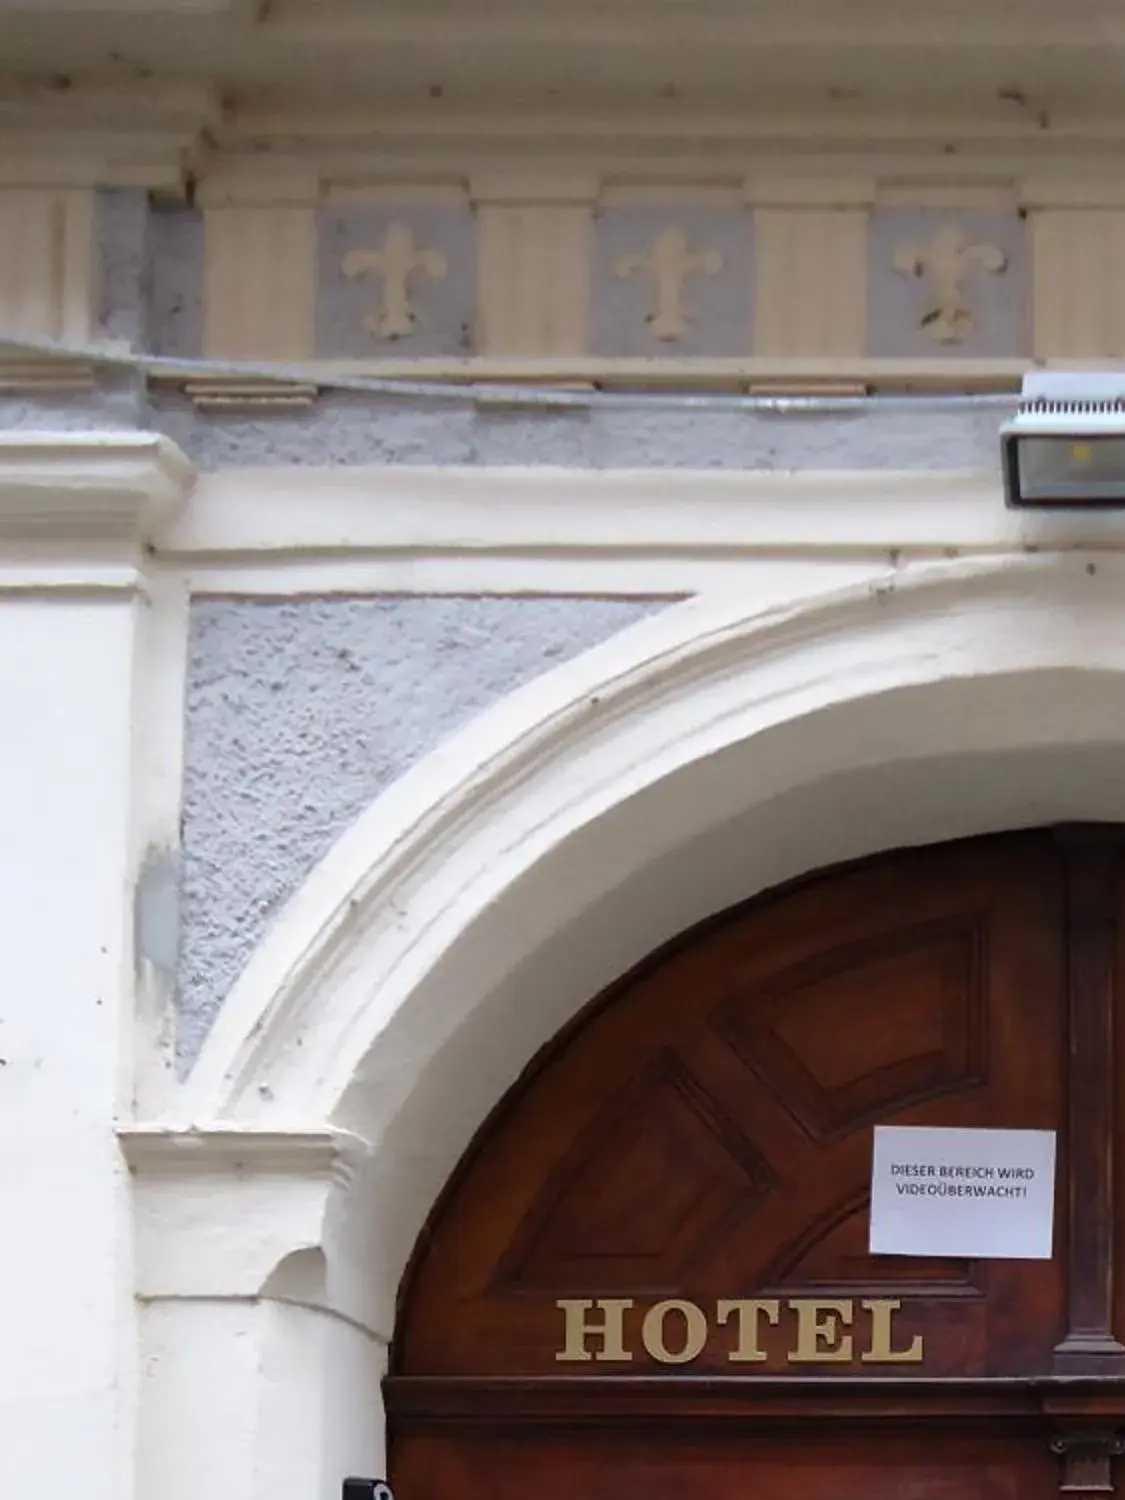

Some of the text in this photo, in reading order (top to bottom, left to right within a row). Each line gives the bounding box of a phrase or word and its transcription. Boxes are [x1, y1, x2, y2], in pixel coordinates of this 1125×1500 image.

[891, 1163, 1035, 1180] DIESER BEREICH WIRD
[896, 1180, 1027, 1198] VIDEOÜBERWACHT!
[555, 1299, 923, 1364] HOTEL
